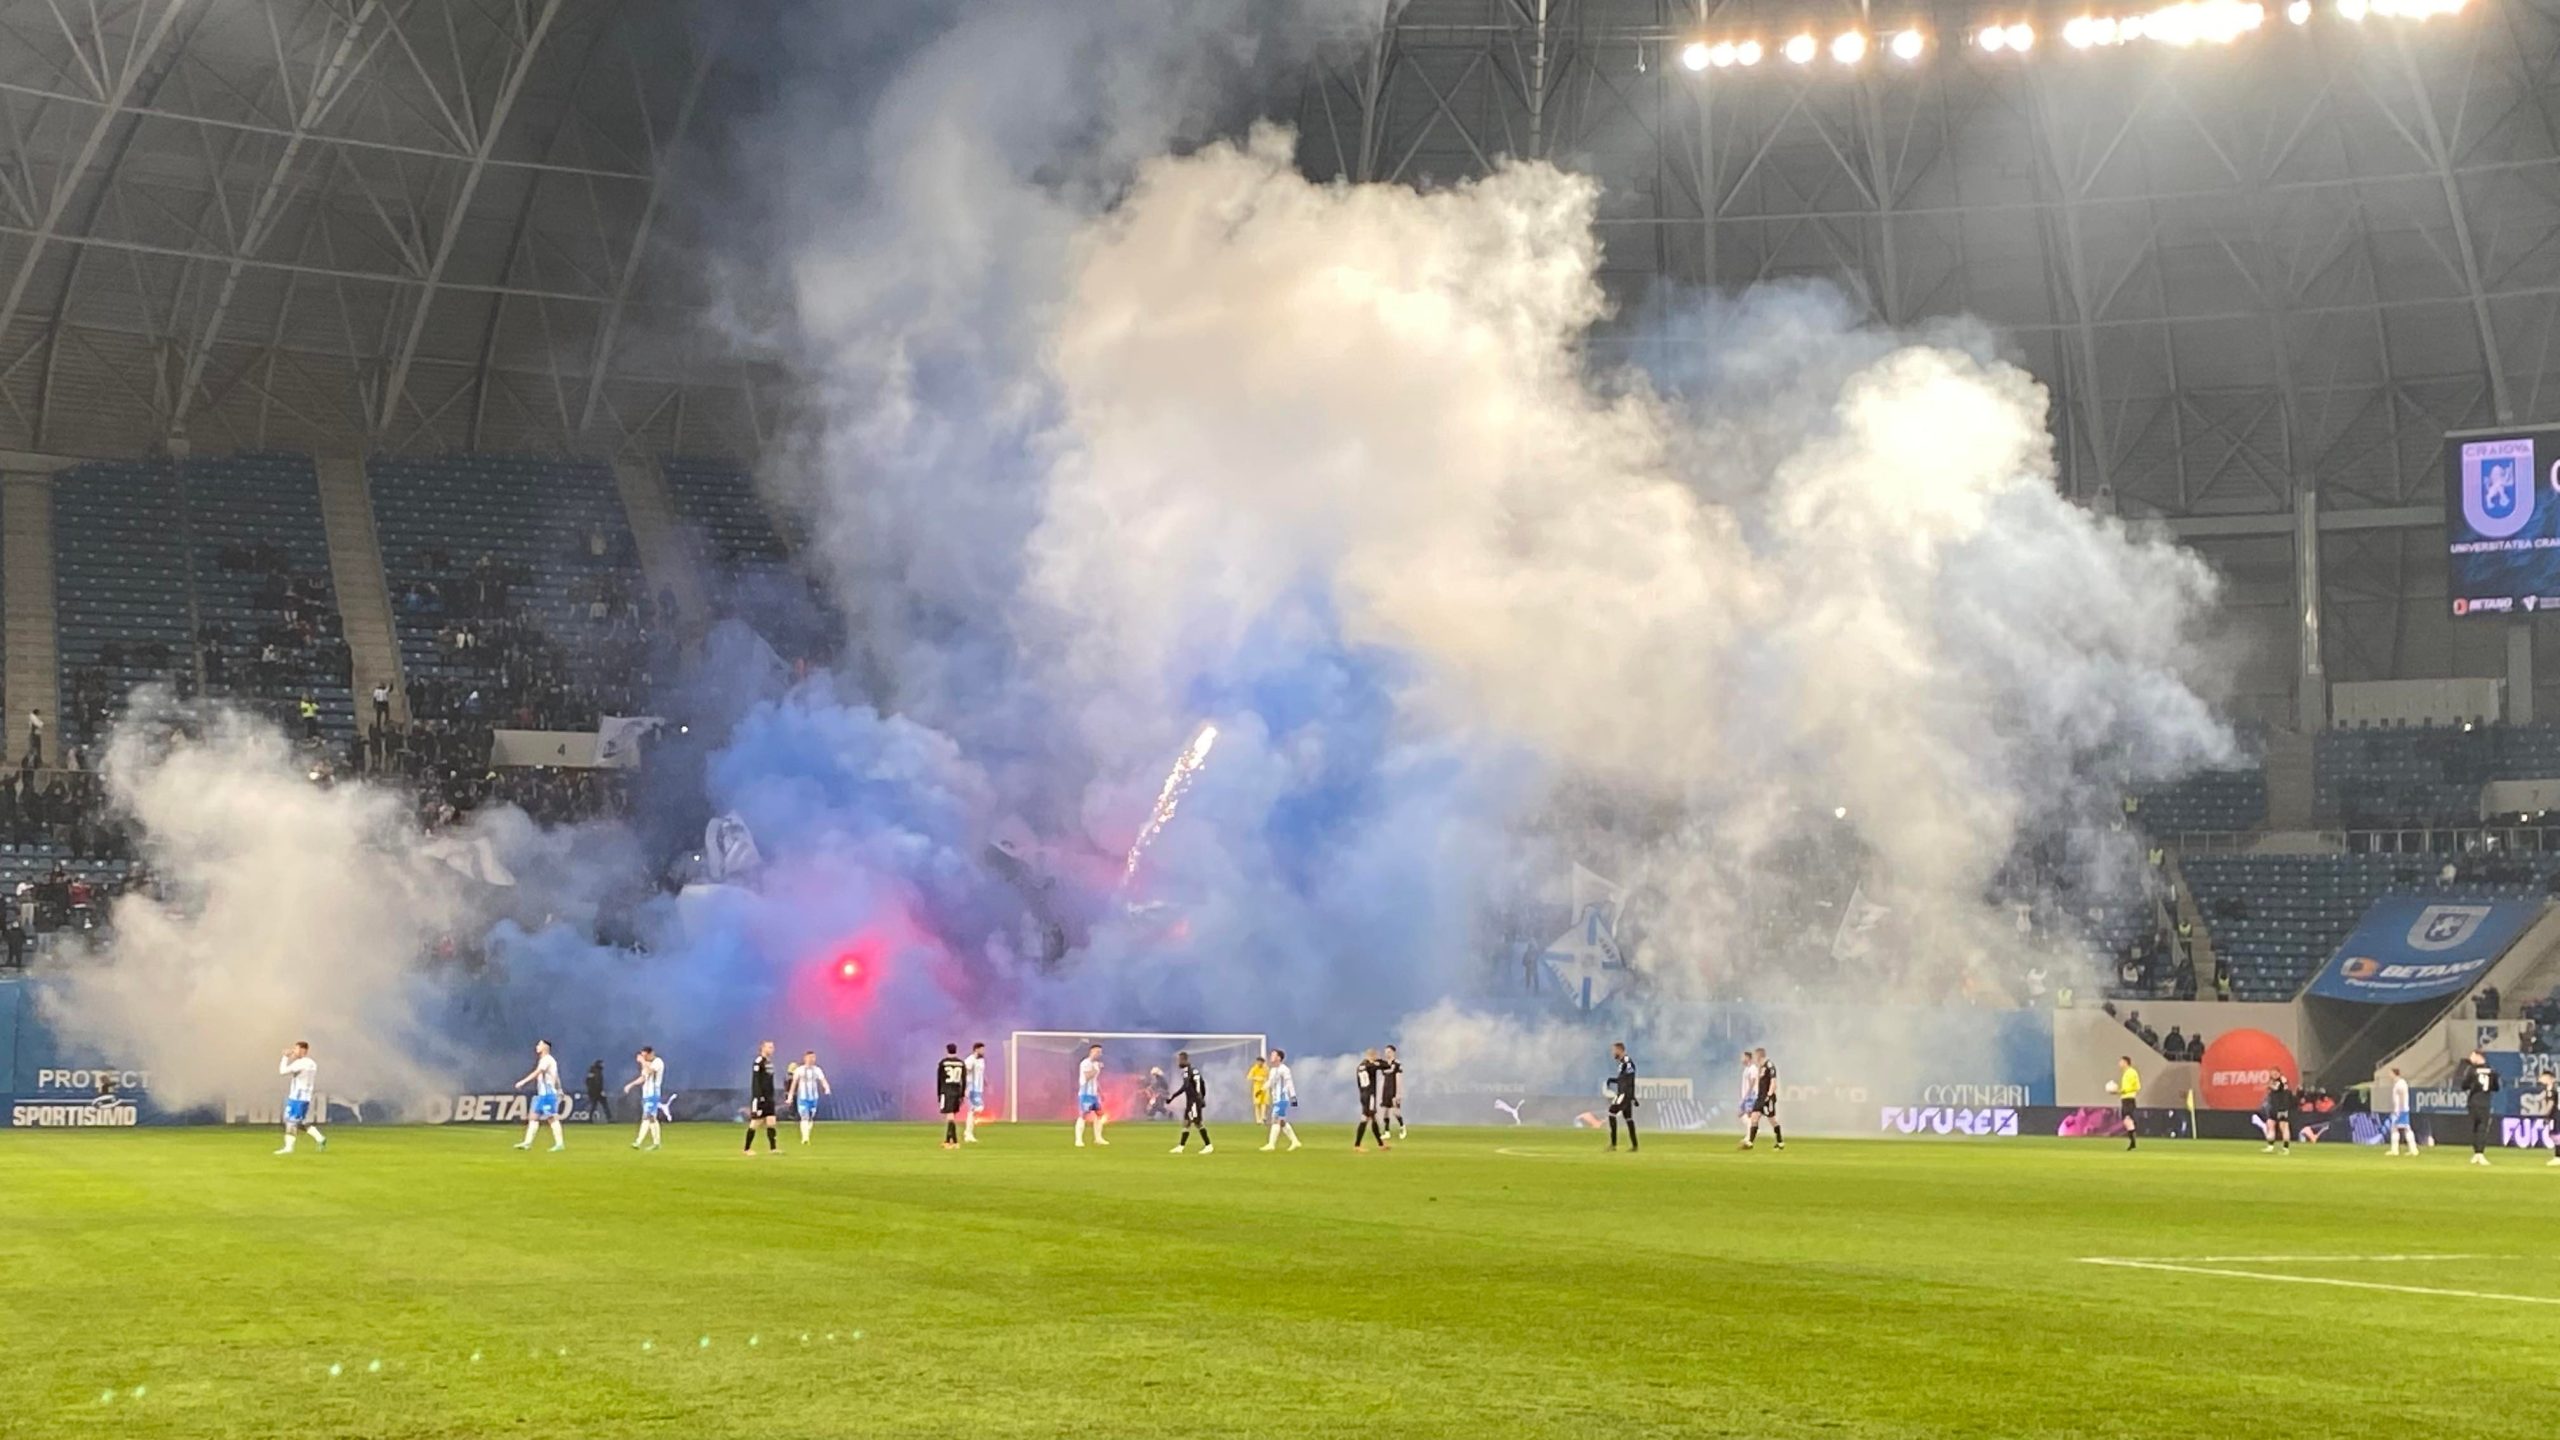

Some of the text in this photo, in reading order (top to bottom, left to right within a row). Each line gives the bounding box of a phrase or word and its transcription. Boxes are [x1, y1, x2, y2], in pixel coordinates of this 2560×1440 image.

[2379, 959, 2486, 978] BETANO
[943, 1066, 963, 1083] 30
[2212, 1070, 2270, 1086] BETANO
[1924, 1084, 2030, 1107] COTNARI
[13, 1106, 137, 1126] SPORTISIMO
